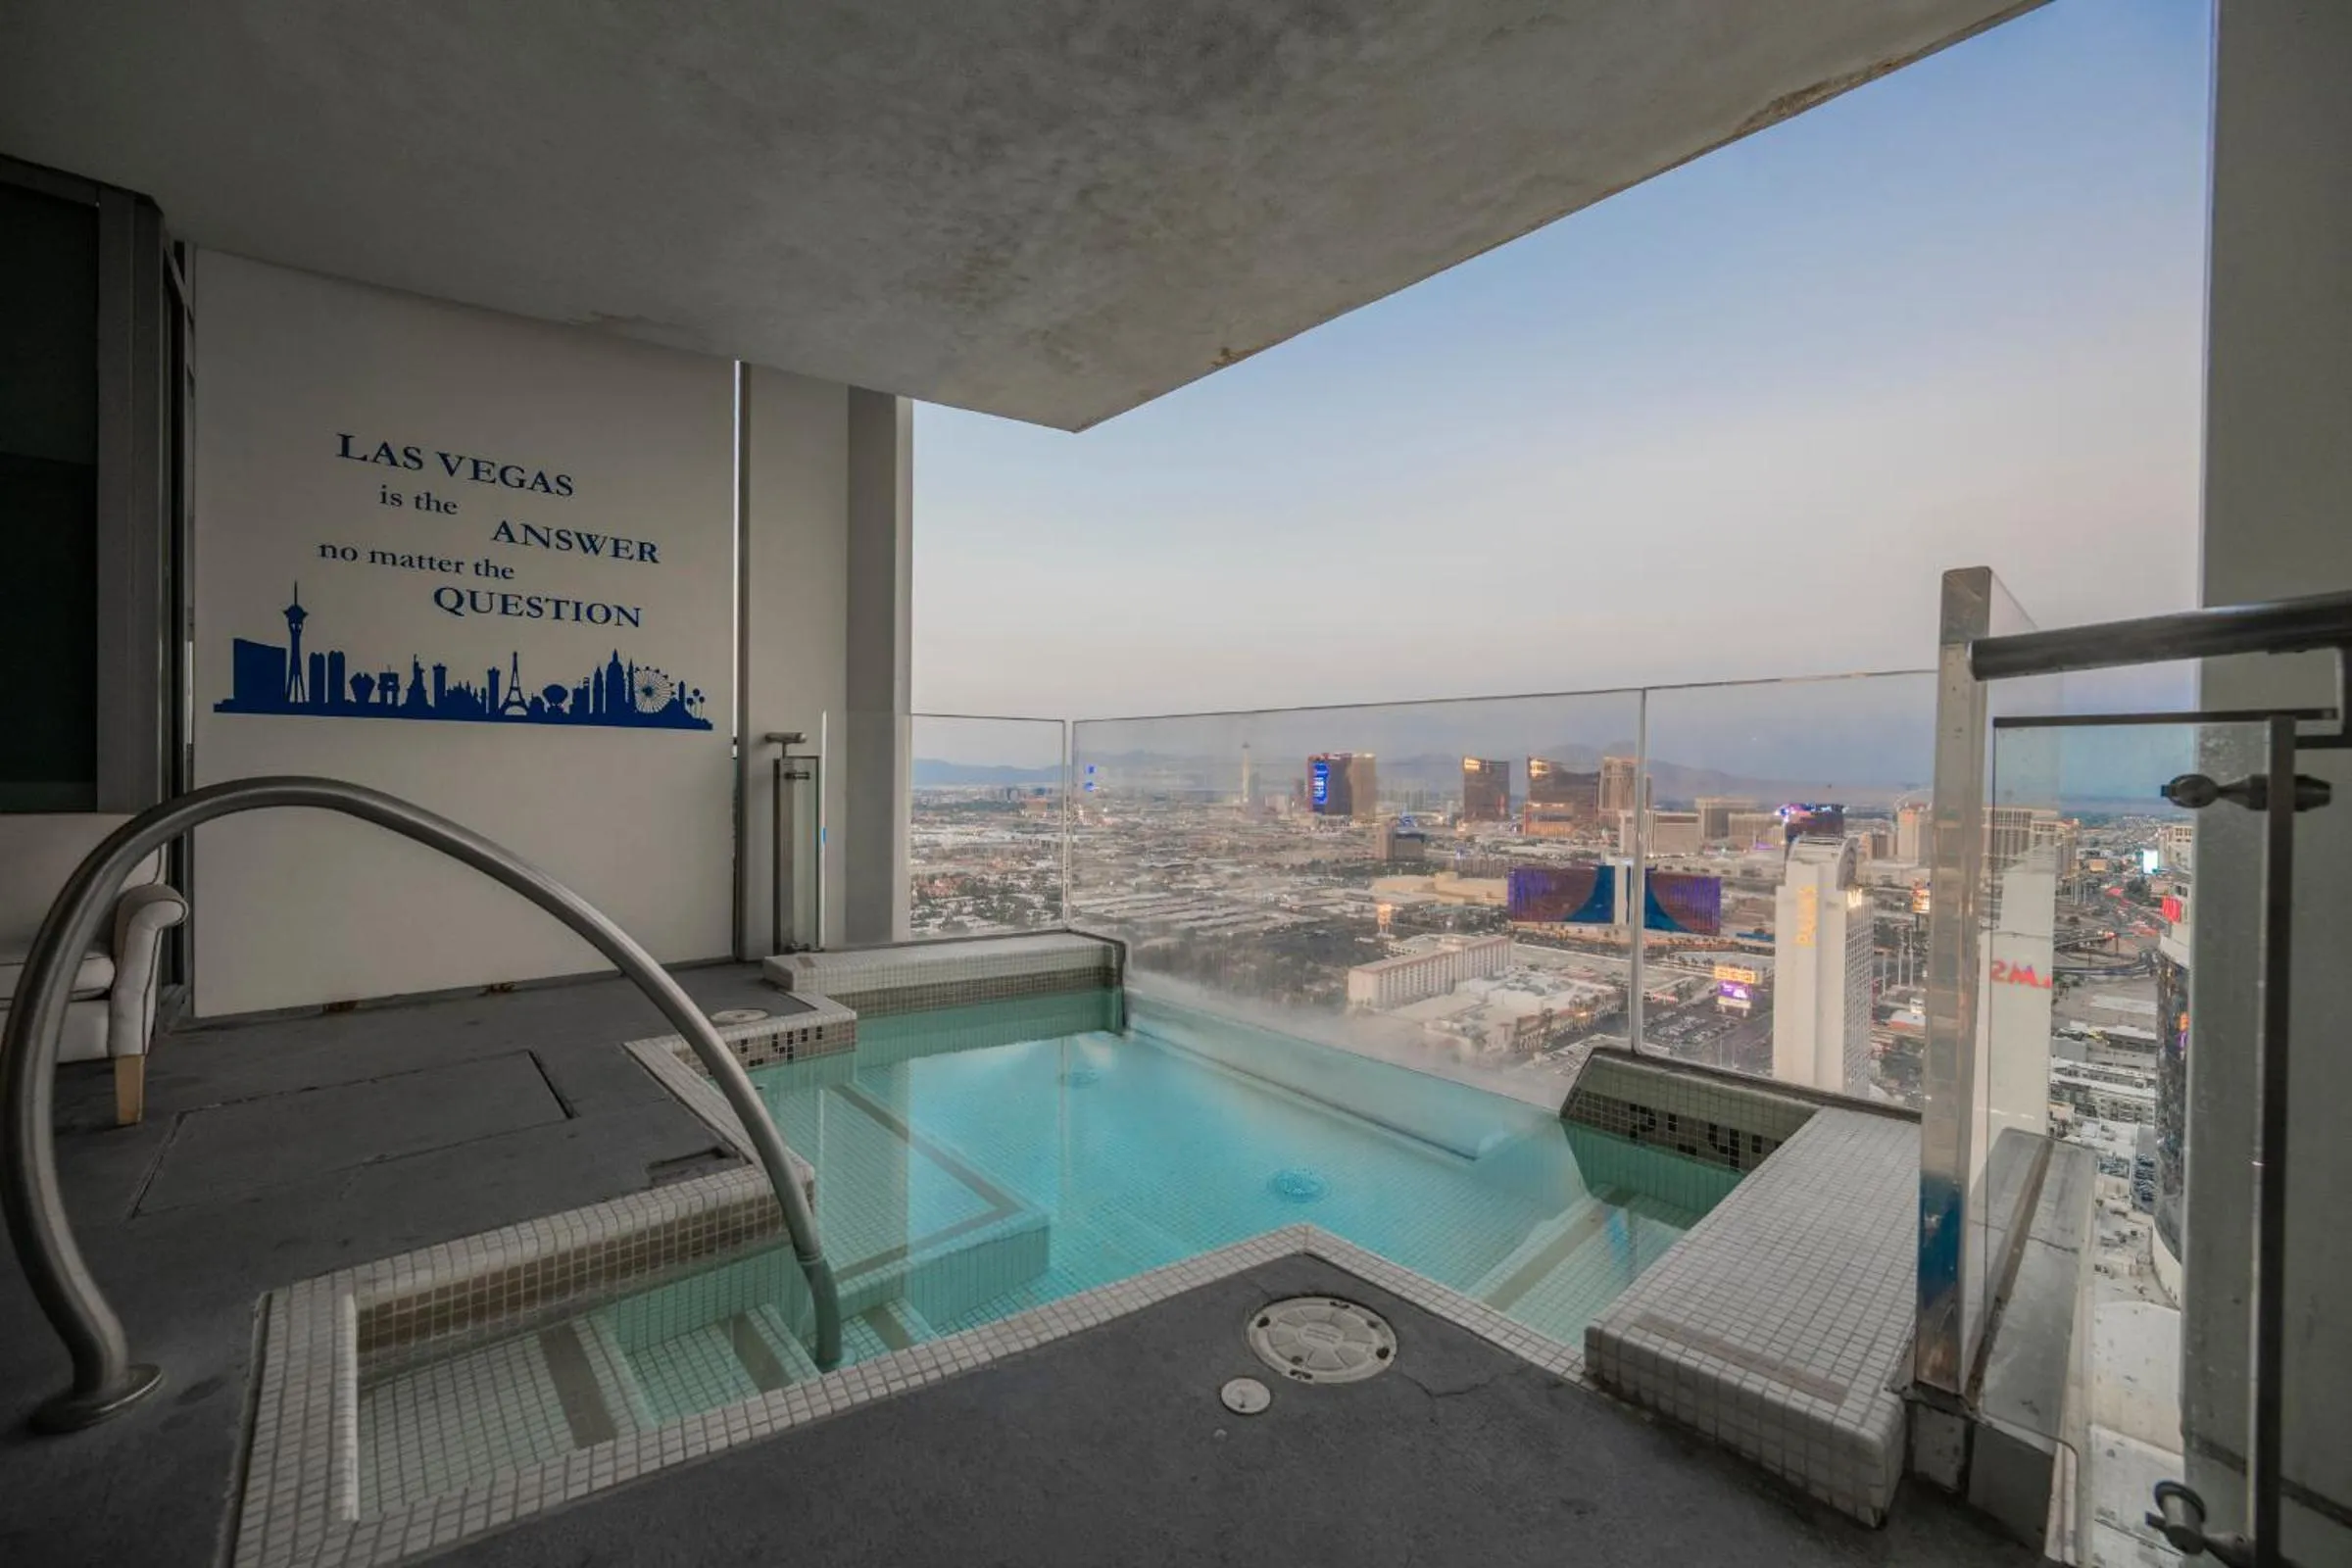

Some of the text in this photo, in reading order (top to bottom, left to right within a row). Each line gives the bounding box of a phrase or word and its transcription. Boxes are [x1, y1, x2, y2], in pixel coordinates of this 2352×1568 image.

[336, 434, 574, 498] LAS VEGAS
[379, 483, 459, 515] is the
[318, 543, 515, 580] no matter the
[491, 519, 661, 564] ANSWER
[433, 585, 642, 628] QUESTION
